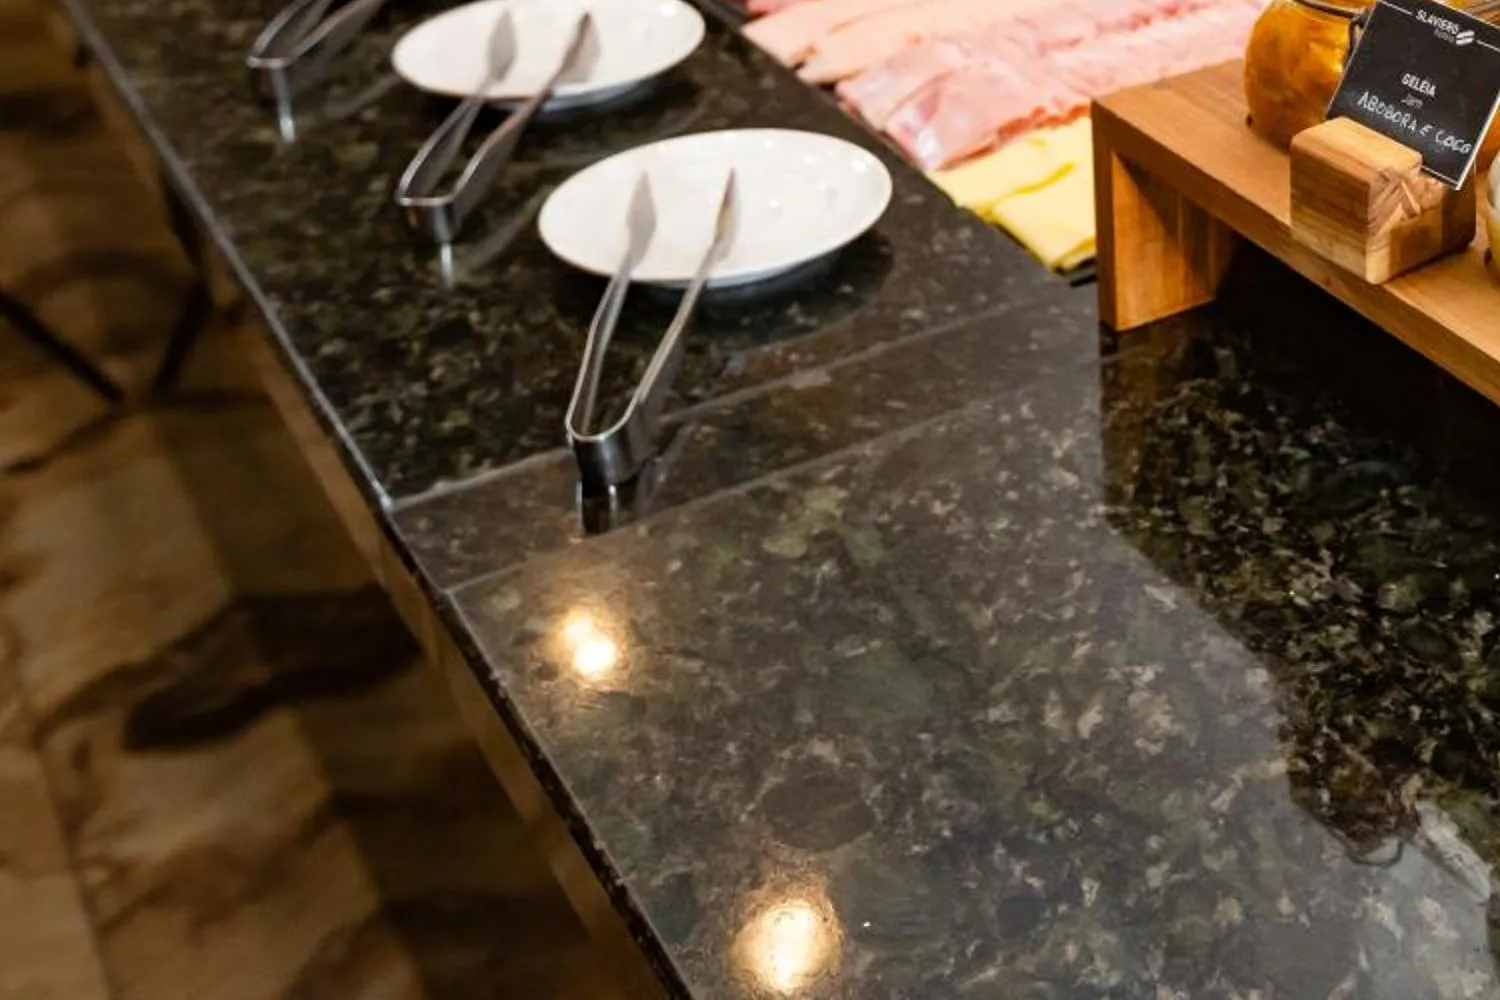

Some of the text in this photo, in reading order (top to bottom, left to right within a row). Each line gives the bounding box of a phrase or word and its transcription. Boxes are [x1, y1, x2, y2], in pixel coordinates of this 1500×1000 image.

[1415, 9, 1460, 35] SLAVIERO
[1357, 91, 1418, 131] ABOBORA
[1419, 125, 1434, 137] E
